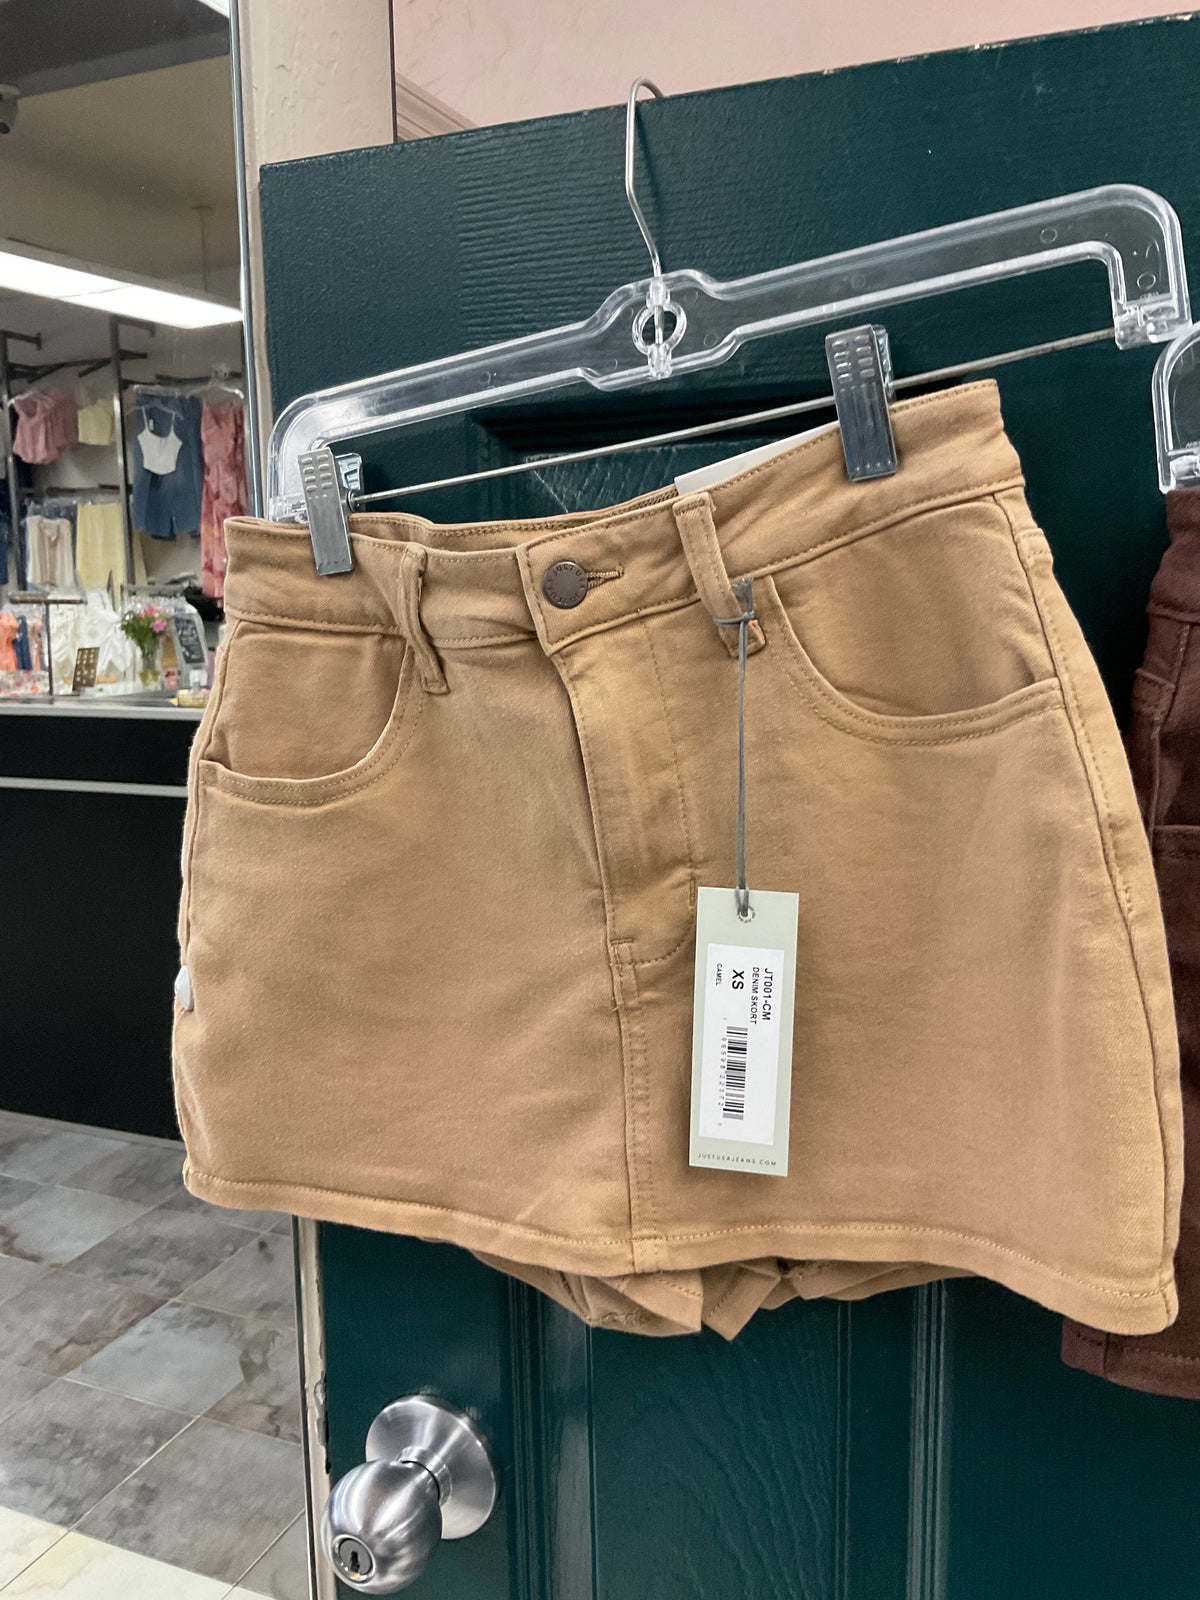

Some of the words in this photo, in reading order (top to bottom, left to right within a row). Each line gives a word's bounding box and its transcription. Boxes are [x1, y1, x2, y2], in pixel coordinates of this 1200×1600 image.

[715, 963, 723, 986] CAMEL
[731, 969, 745, 990] XS
[751, 967, 760, 994] DENIM
[761, 967, 774, 1021] JT001-CM
[750, 996, 759, 1024] SKORT
[697, 1153, 777, 1166] JUSTUSAJEANSCOM
